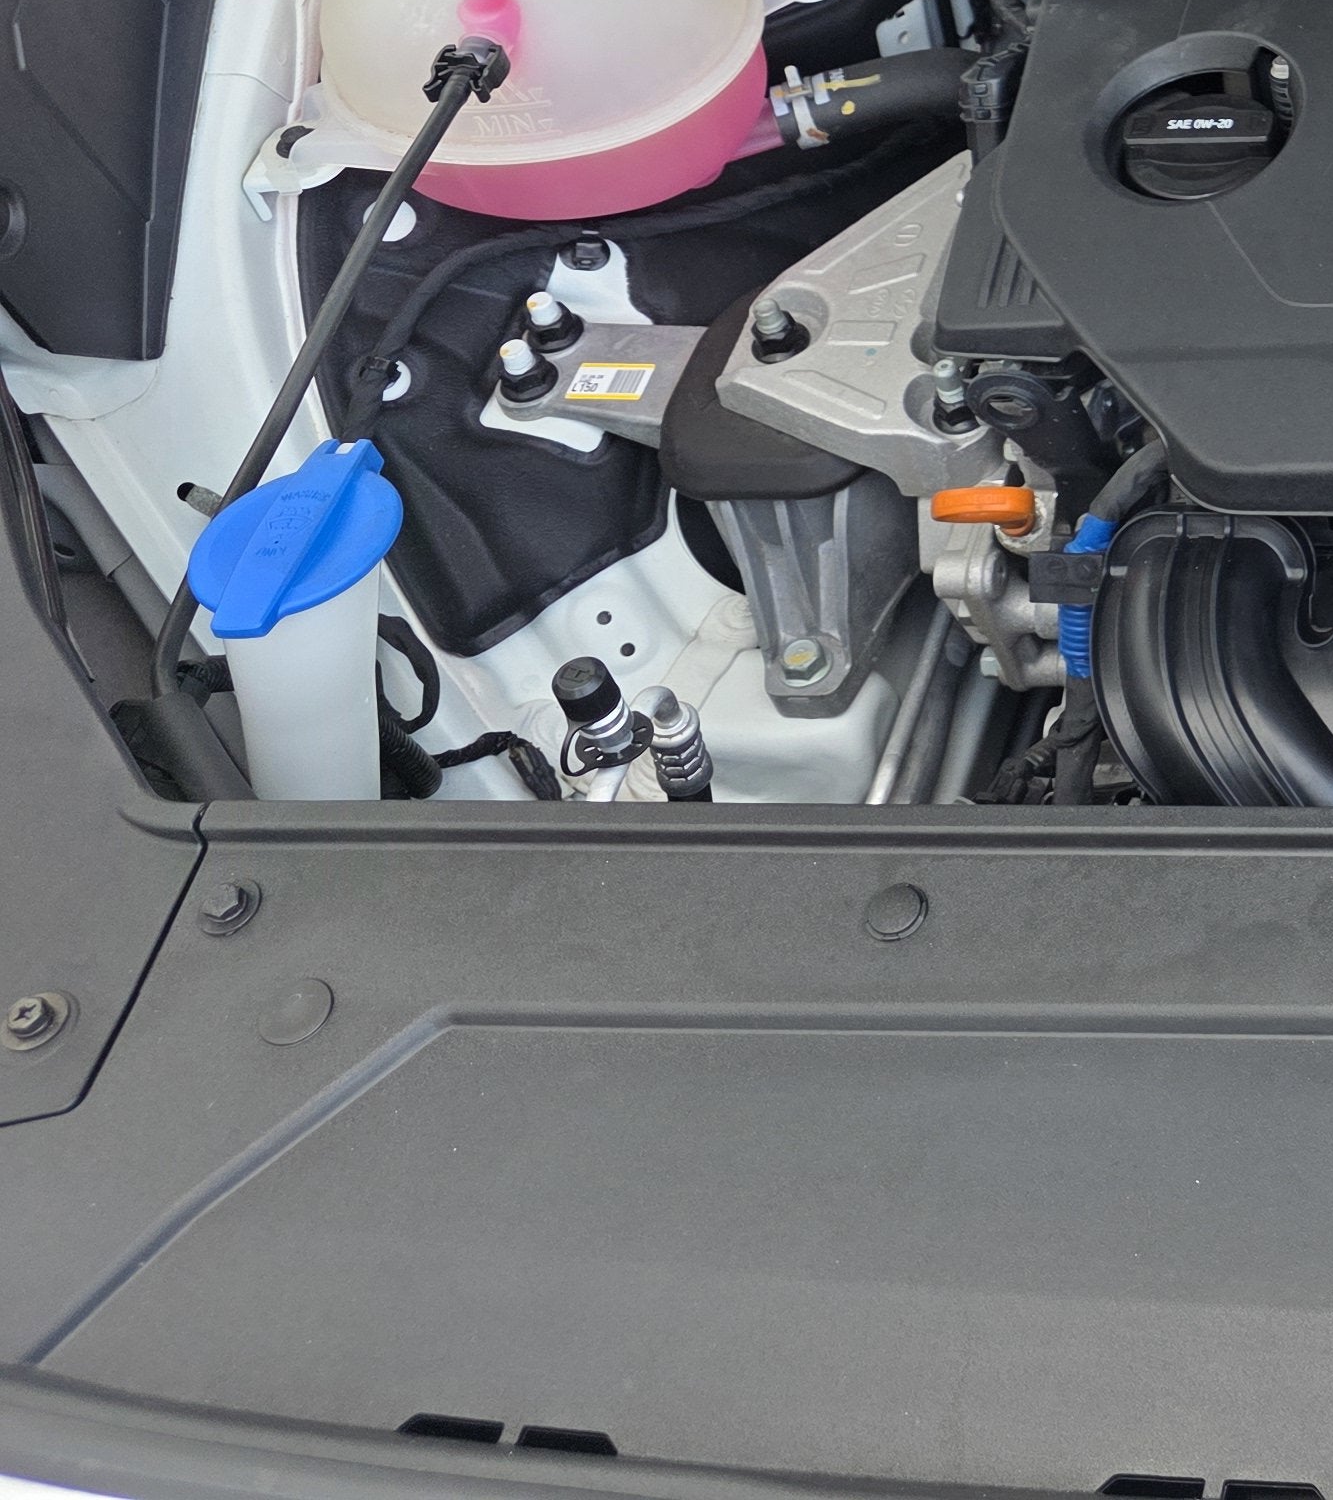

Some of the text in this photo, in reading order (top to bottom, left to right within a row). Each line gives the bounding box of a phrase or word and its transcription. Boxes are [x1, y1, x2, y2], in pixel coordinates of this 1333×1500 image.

[473, 112, 537, 137] MIN
[1166, 118, 1234, 130] SAE 0W-20
